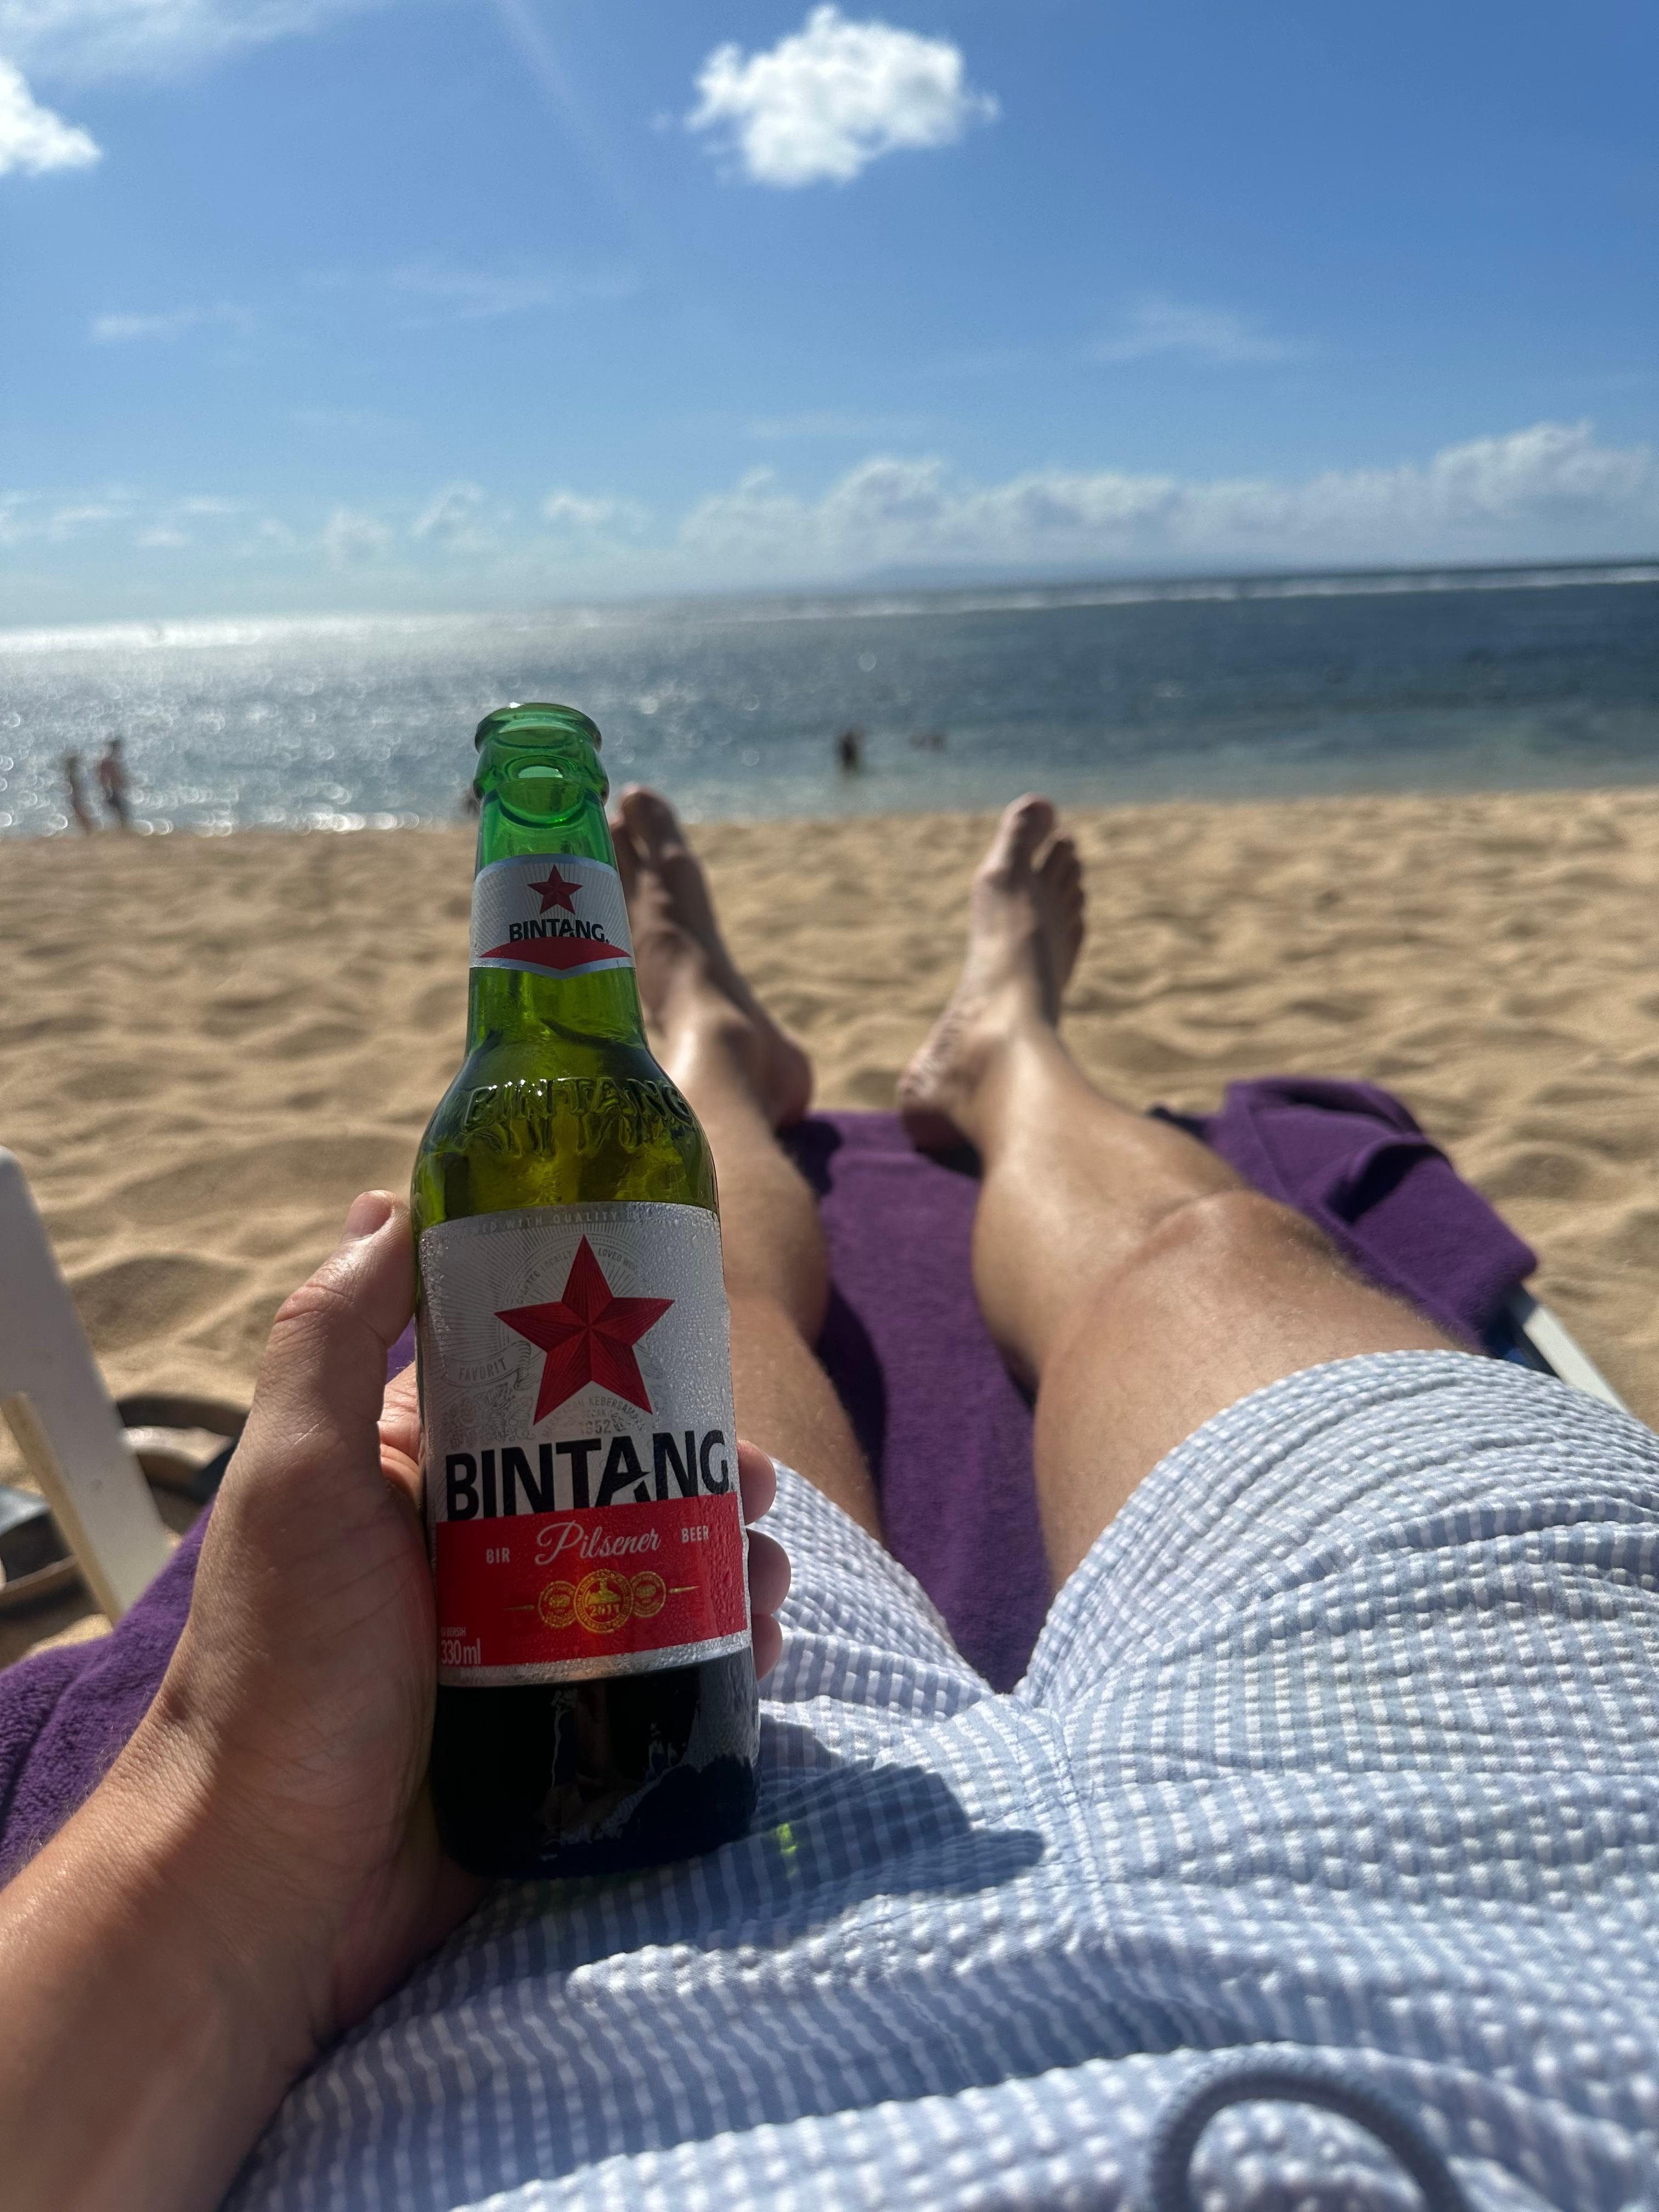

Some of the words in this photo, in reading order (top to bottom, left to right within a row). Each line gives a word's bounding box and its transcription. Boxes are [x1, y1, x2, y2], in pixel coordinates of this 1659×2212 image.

[509, 918, 606, 943] BINTANG
[461, 1076, 693, 1132] BINTANG
[506, 1215, 543, 1229] WITH
[552, 1210, 618, 1224] QUALITY
[541, 1250, 572, 1271] LOCALLY
[598, 1247, 622, 1262] LOVED
[459, 1357, 506, 1381] FAVORIT
[579, 1418, 612, 1435] 1952
[445, 1429, 729, 1521] BINTANG
[486, 1547, 510, 1564] BIR
[534, 1521, 662, 1566] Pilsener
[681, 1525, 709, 1543] BEER
[590, 1604, 620, 1617] 2011
